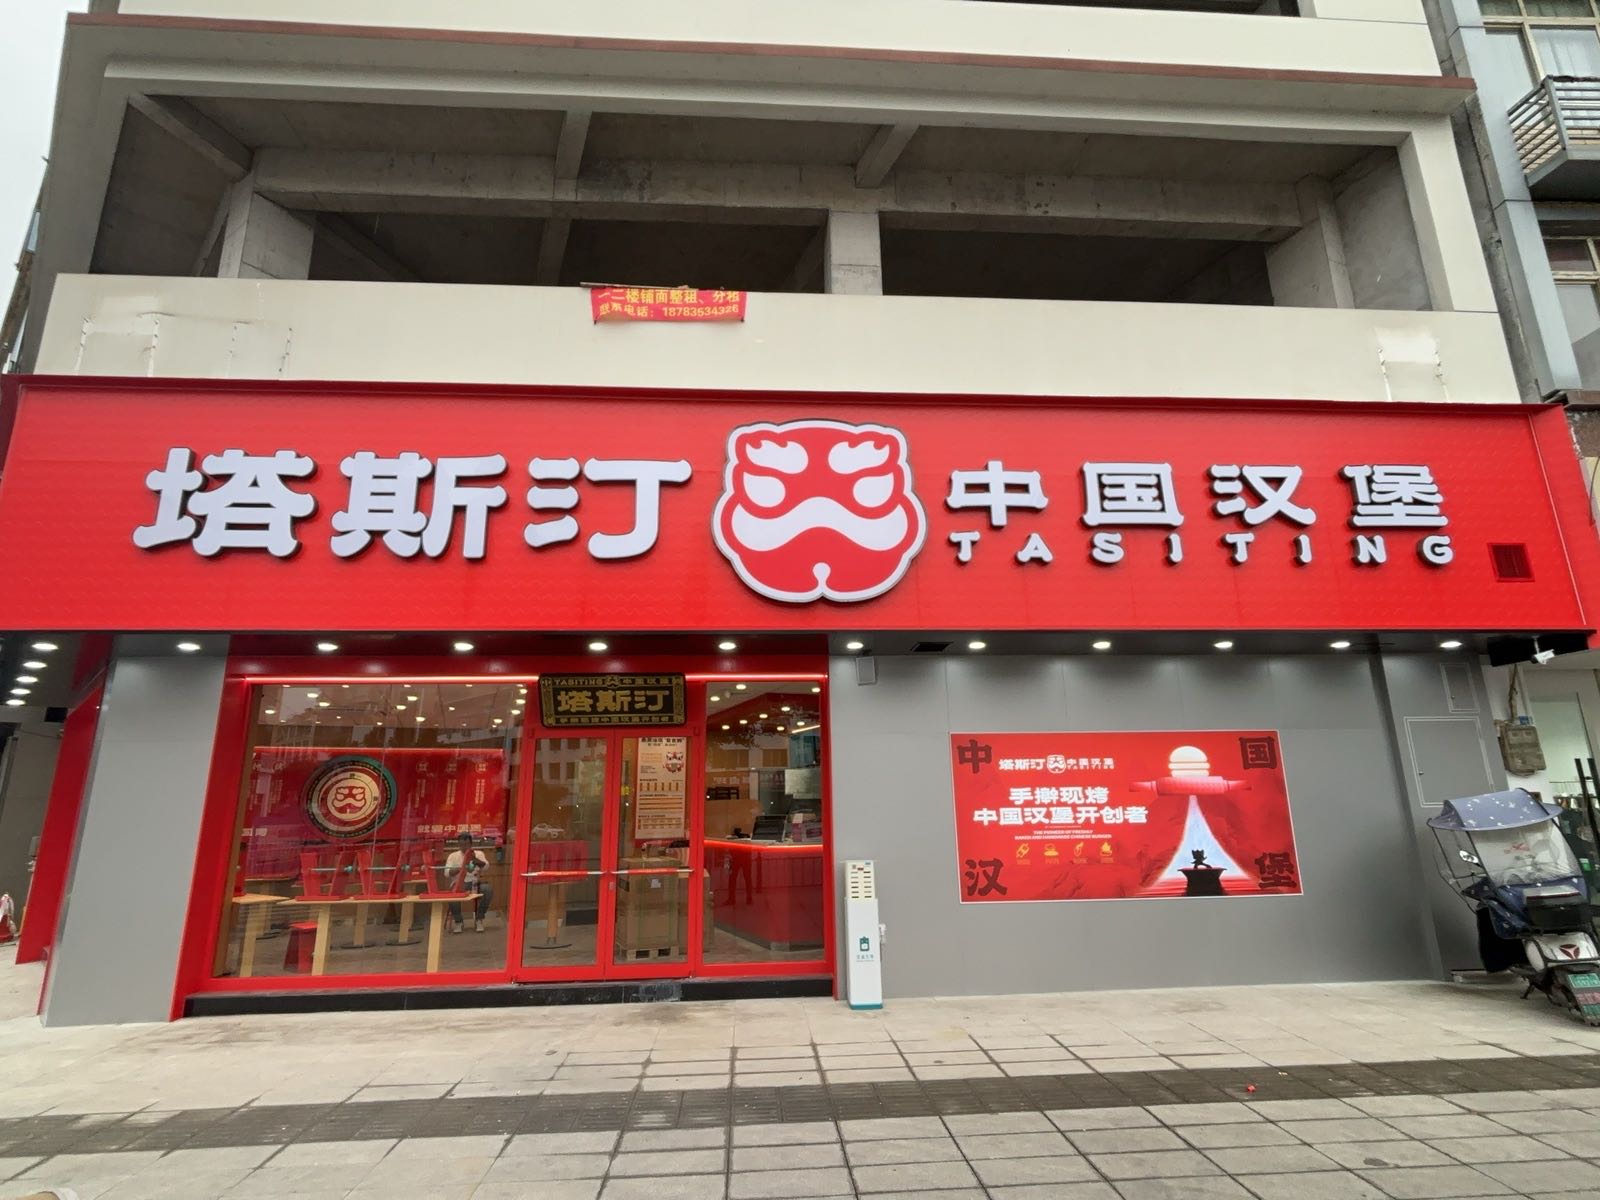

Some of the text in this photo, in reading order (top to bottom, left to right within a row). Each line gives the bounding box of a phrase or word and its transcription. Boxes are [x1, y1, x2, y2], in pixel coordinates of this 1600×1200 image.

[132, 447, 692, 560] 塔斯汀
[946, 460, 1449, 528] 中国汉堡
[949, 532, 1454, 565] TASITING
[557, 689, 670, 712] 塔斯汀
[957, 739, 992, 774] 中
[998, 758, 1046, 771] 塔斯汀
[1239, 736, 1278, 771] 国
[1009, 787, 1109, 805] 手擀现烤
[973, 806, 1149, 826] 中国汉堡开创者
[965, 858, 1007, 896] 汉
[1254, 852, 1298, 890] 堡
